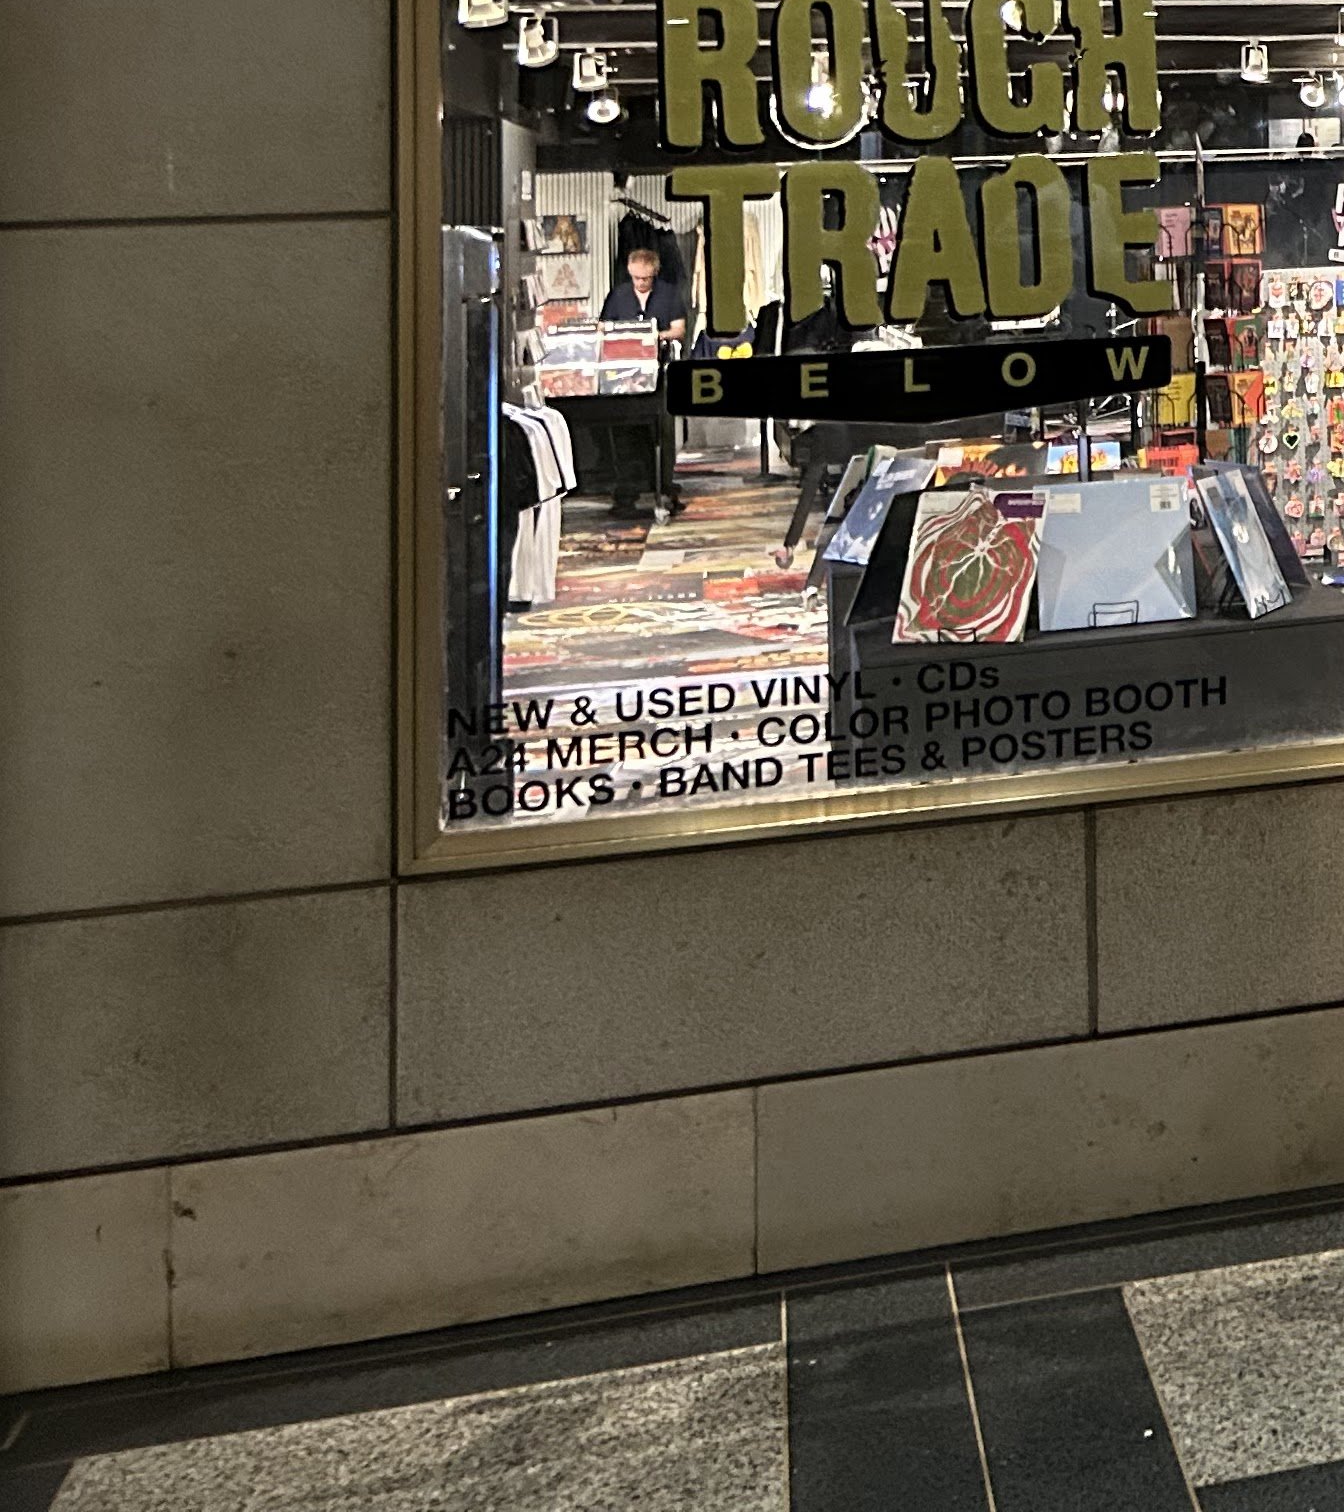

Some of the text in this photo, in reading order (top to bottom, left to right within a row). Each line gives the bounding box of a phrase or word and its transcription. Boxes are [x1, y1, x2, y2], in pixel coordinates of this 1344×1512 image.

[665, 154, 1174, 340] TRADE
[691, 345, 1149, 405] BELOW
[446, 660, 1000, 739] NEW & USED VINYL CDs
[446, 675, 1228, 781] A24 MERCH COLOR PHOTO BOOTH
[446, 720, 1154, 822] BOOKS BAND TEES & POSTERS
